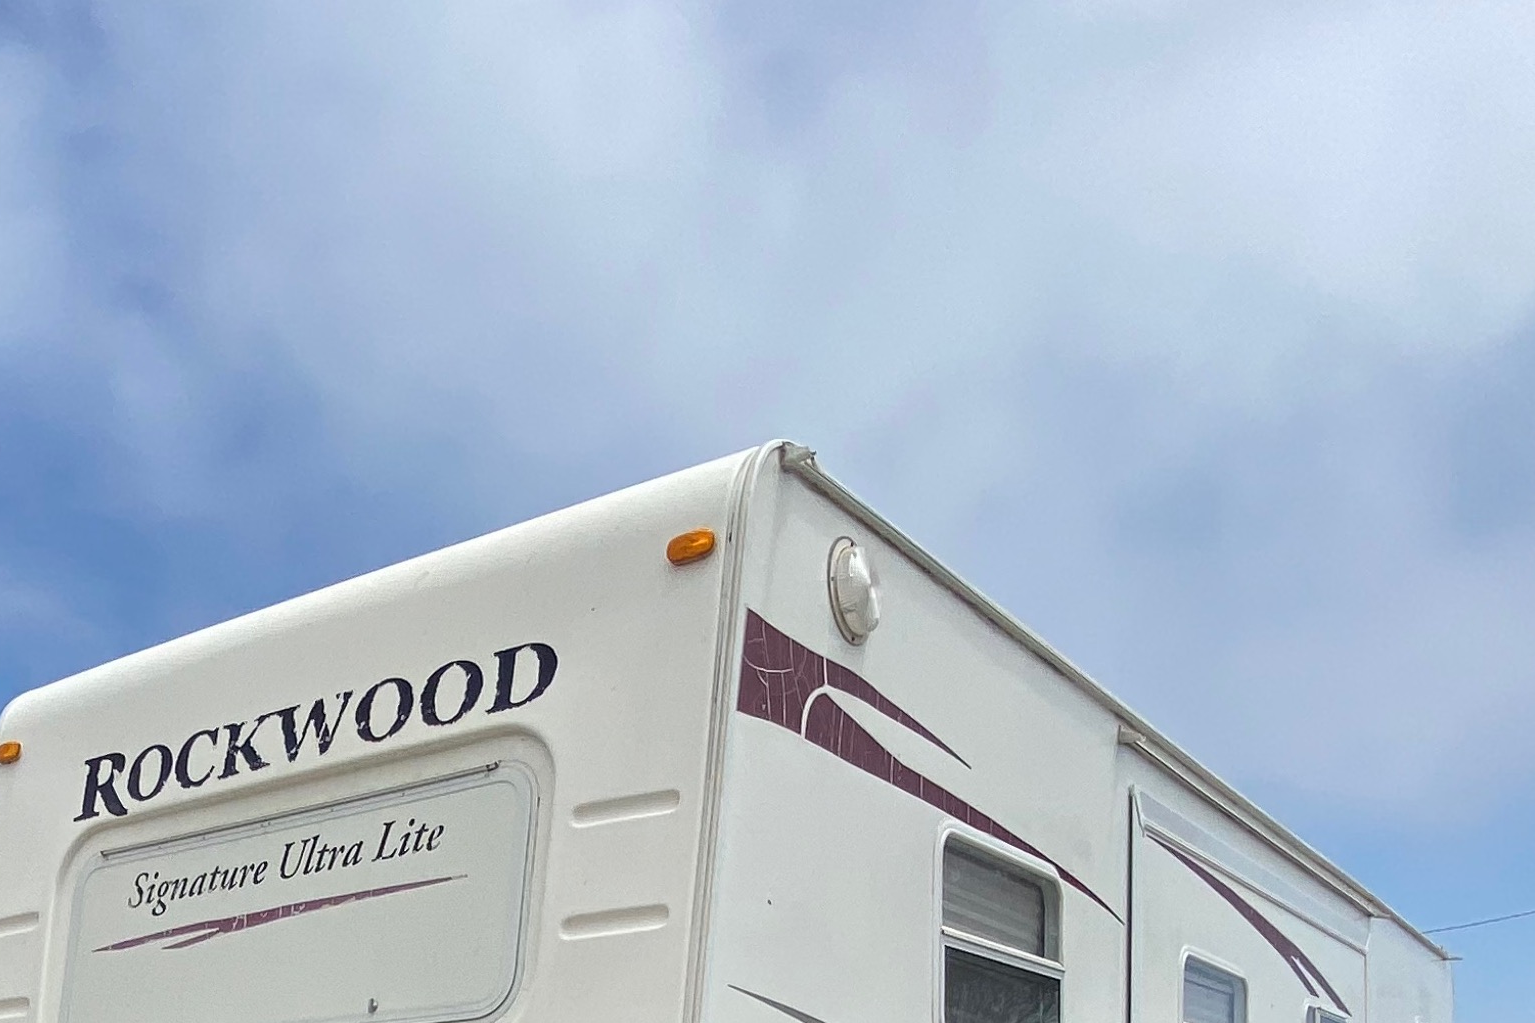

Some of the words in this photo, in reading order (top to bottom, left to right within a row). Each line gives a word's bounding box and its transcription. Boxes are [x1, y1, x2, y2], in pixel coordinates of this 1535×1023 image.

[72, 642, 558, 823] ROCKWOOD
[127, 859, 269, 917] Signature
[279, 834, 364, 880] Ultra
[371, 819, 445, 862] Lite
